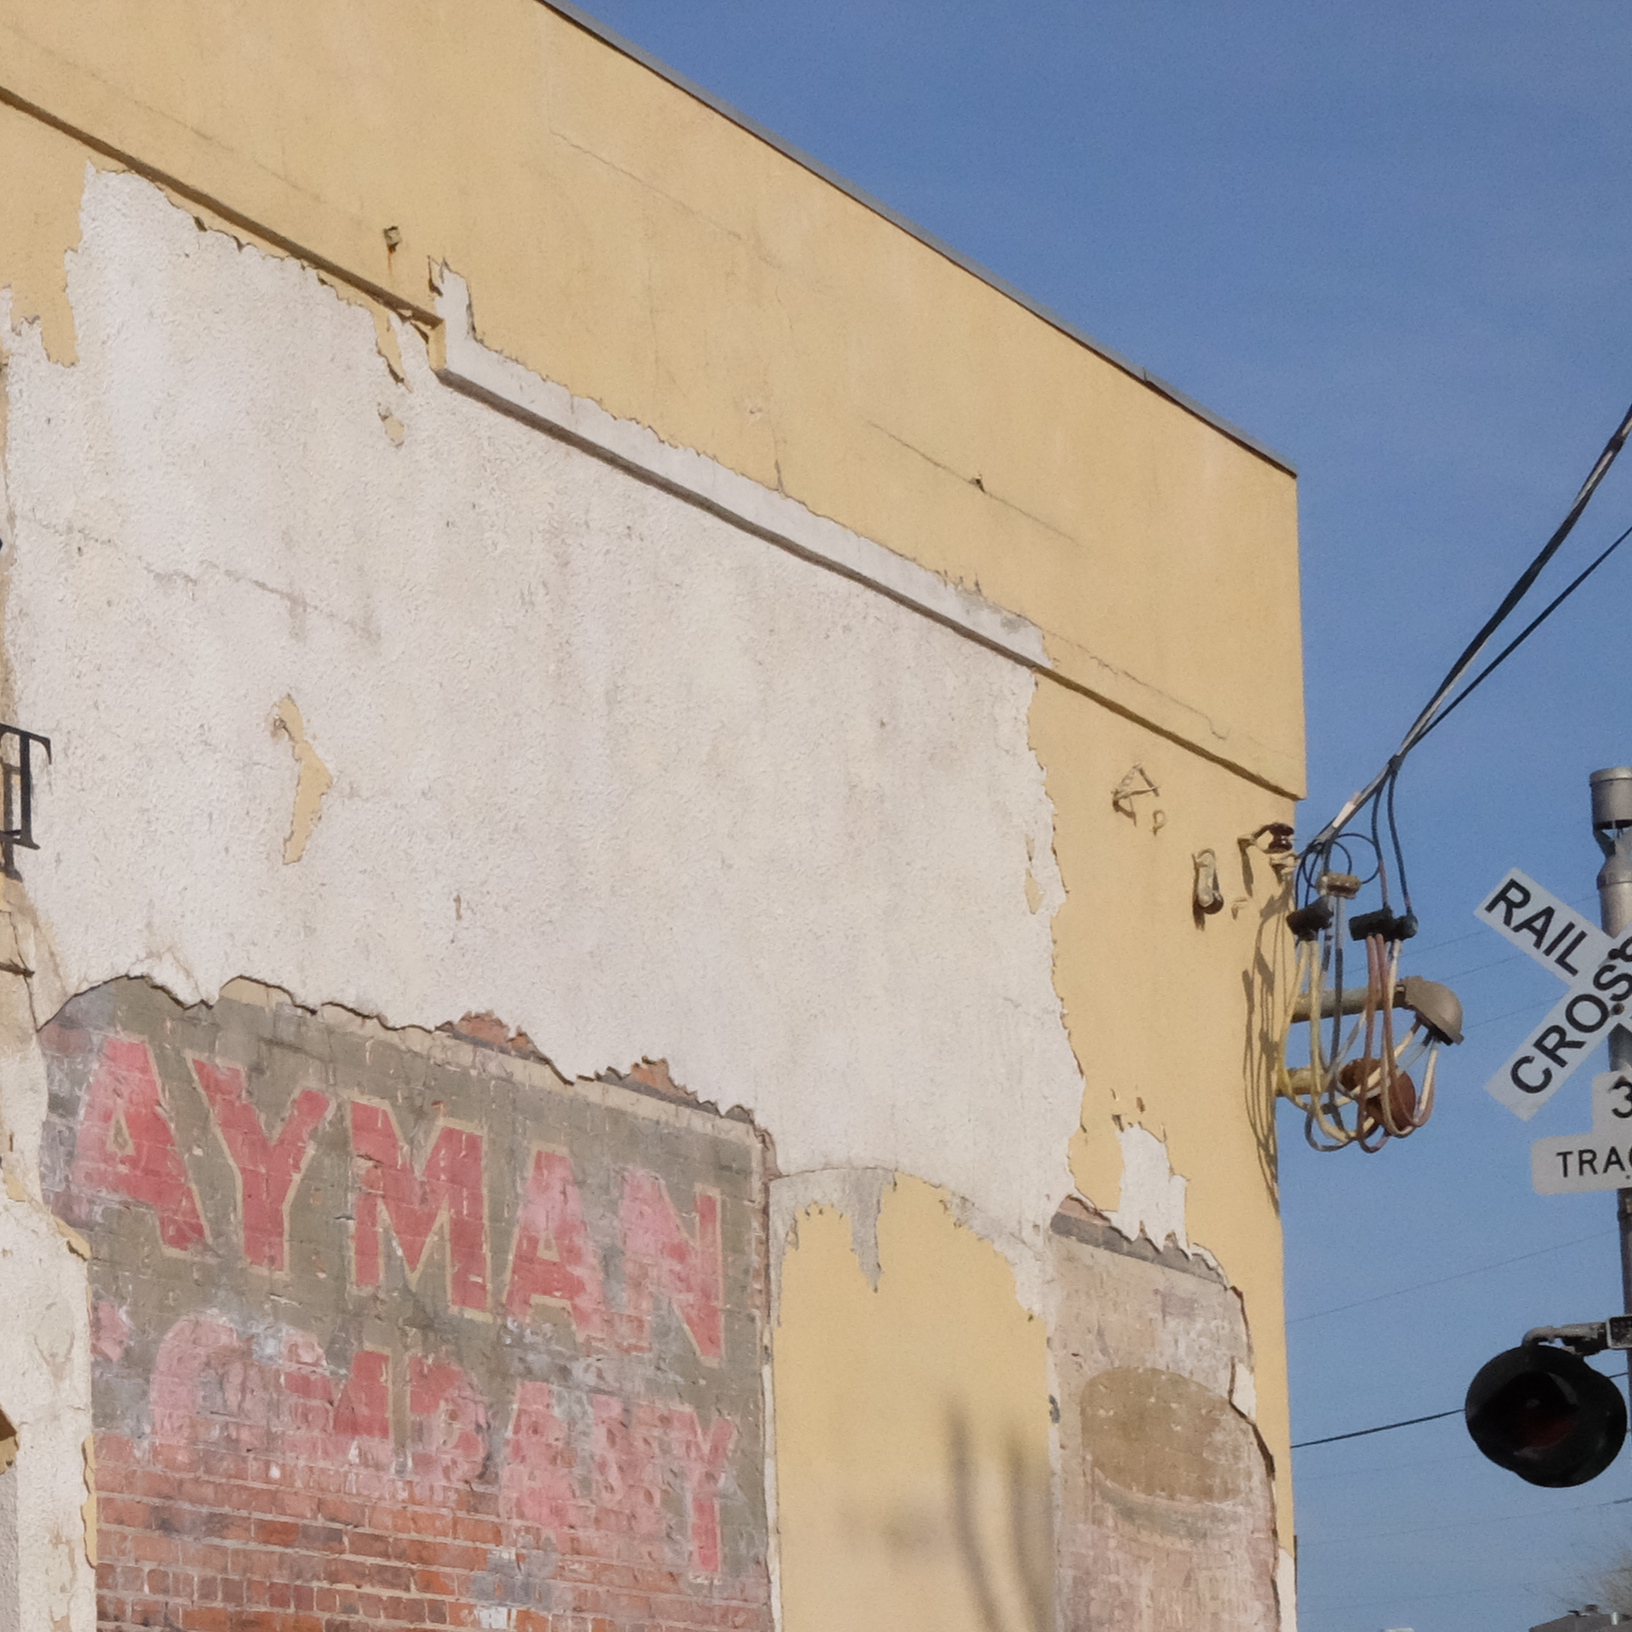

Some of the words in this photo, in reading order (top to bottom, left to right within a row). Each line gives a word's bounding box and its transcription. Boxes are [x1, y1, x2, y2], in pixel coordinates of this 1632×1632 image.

[1484, 878, 1588, 977] RAIL
[72, 1034, 723, 1369] AYMAN
[1555, 1144, 1632, 1178] TRA
